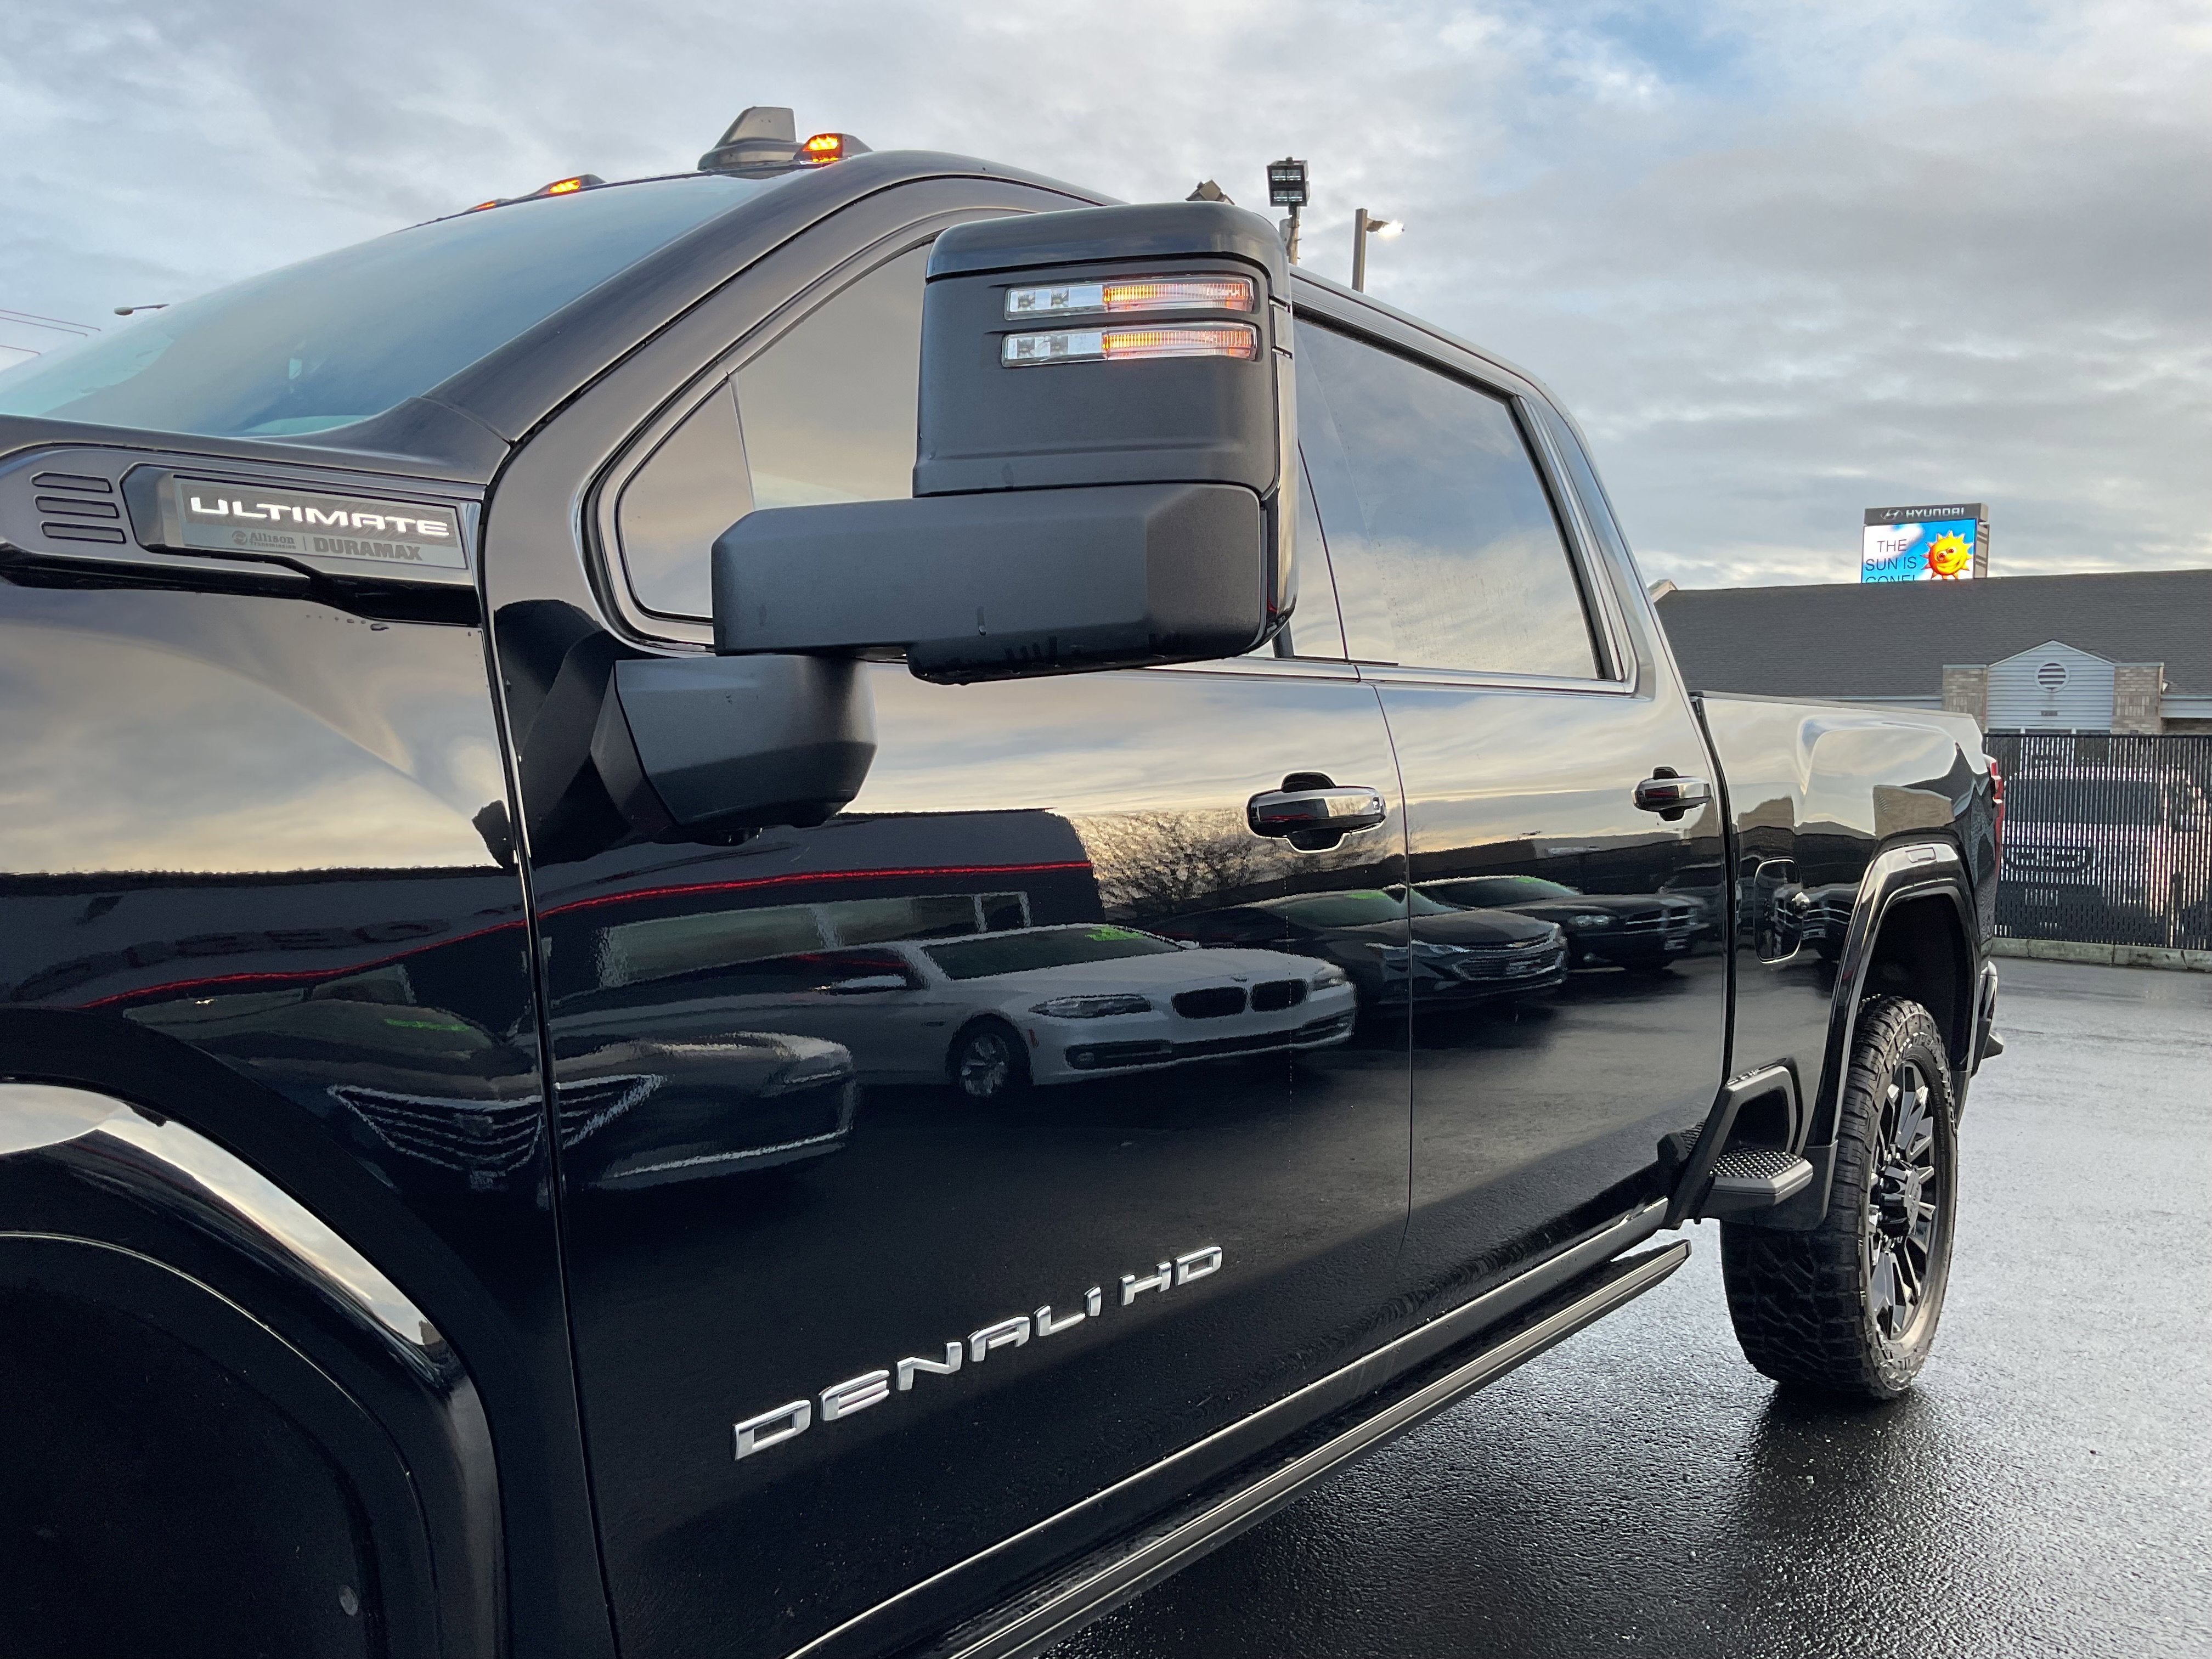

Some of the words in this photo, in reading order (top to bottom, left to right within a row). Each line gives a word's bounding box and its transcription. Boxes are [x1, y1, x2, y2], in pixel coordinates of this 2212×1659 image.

[190, 496, 449, 537] ULTIMATE
[1906, 507, 1965, 518] HYUNDAI
[250, 532, 295, 545] Allison
[1877, 539, 1907, 552] THE
[313, 537, 423, 561] DURAMAX
[1865, 557, 1898, 571] SUN
[1903, 556, 1917, 569] IS
[732, 1286, 1102, 1461] DENALI
[1120, 1246, 1223, 1306] HD
